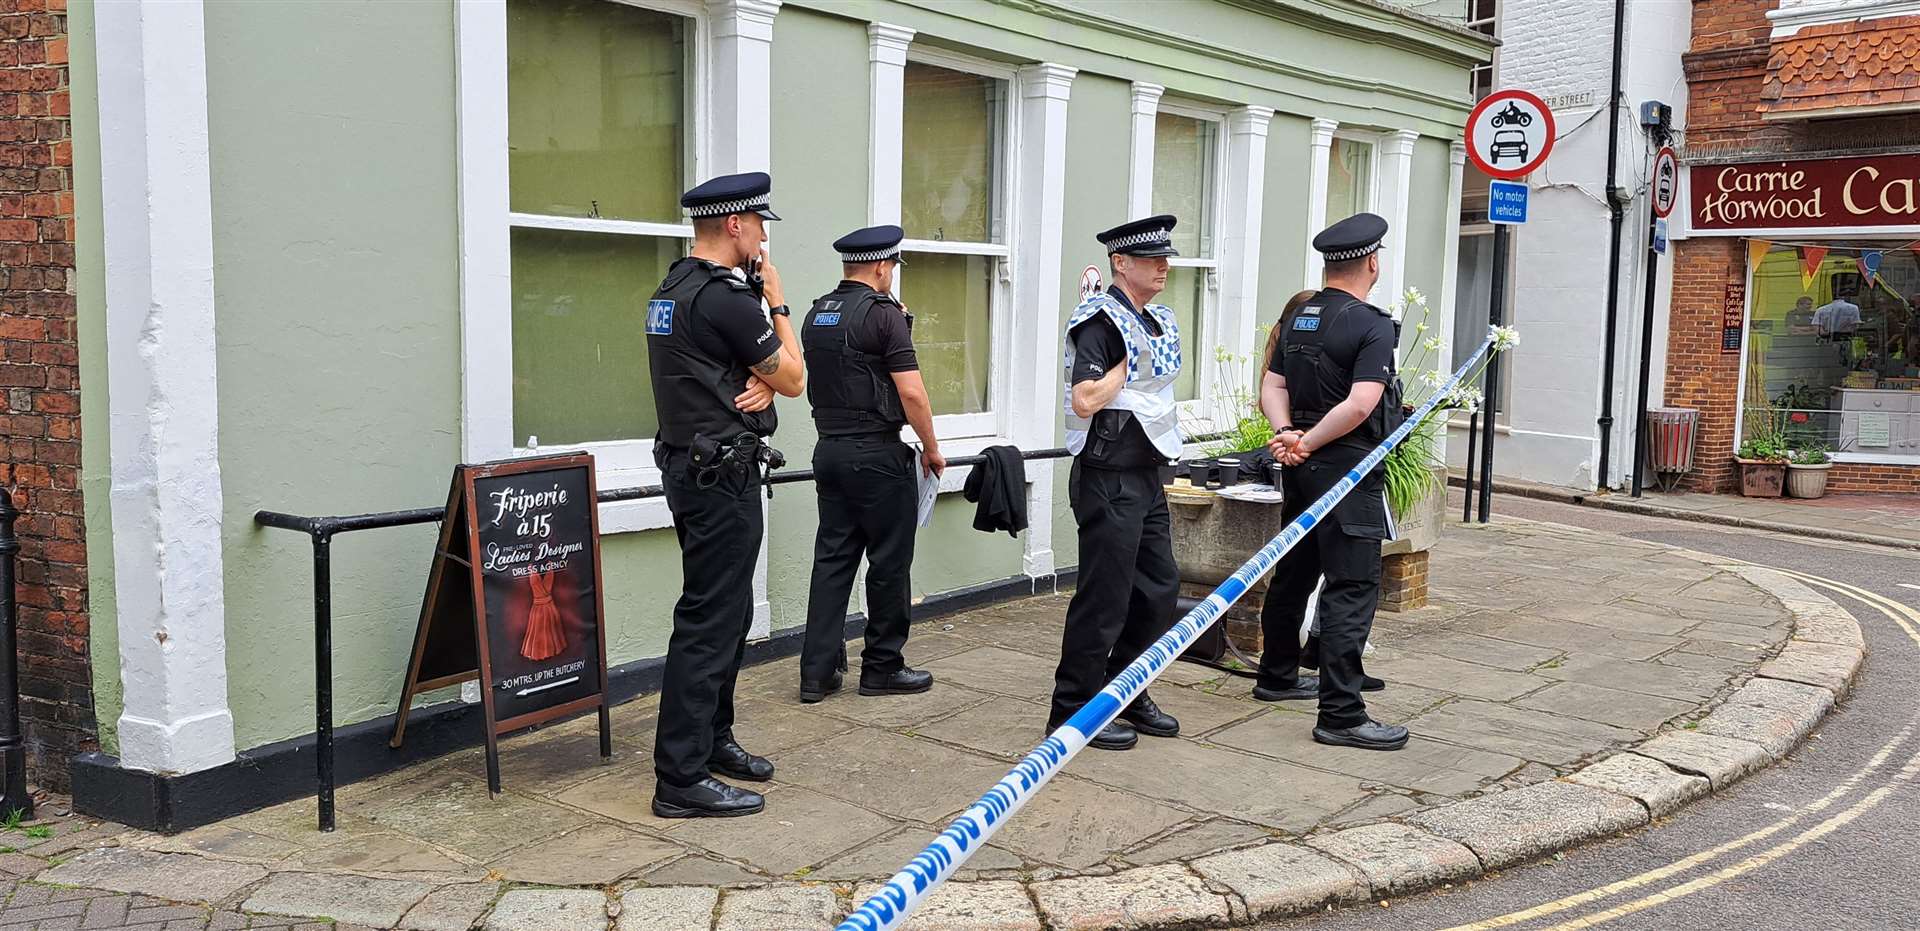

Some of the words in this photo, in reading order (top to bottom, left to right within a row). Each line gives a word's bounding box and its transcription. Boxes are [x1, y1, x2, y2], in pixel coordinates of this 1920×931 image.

[1560, 92, 1591, 106] STREET
[1717, 167, 1807, 193] Carrie
[1843, 166, 1920, 216] Ca
[1493, 188, 1504, 201] No
[1505, 191, 1525, 202] motor
[1699, 187, 1827, 224] Horwood
[1495, 204, 1522, 217] vehicles
[816, 314, 838, 324] POLICE
[1296, 319, 1318, 329] POLICE
[489, 483, 567, 526] Friperie
[484, 542, 531, 572] Ladies
[534, 541, 583, 563] Designer
[512, 564, 538, 577] DRESS
[540, 559, 568, 572] AGENCY
[501, 678, 513, 690] 30
[534, 672, 543, 682] UP
[543, 669, 554, 680] THE
[555, 660, 585, 676] BUTCHERY
